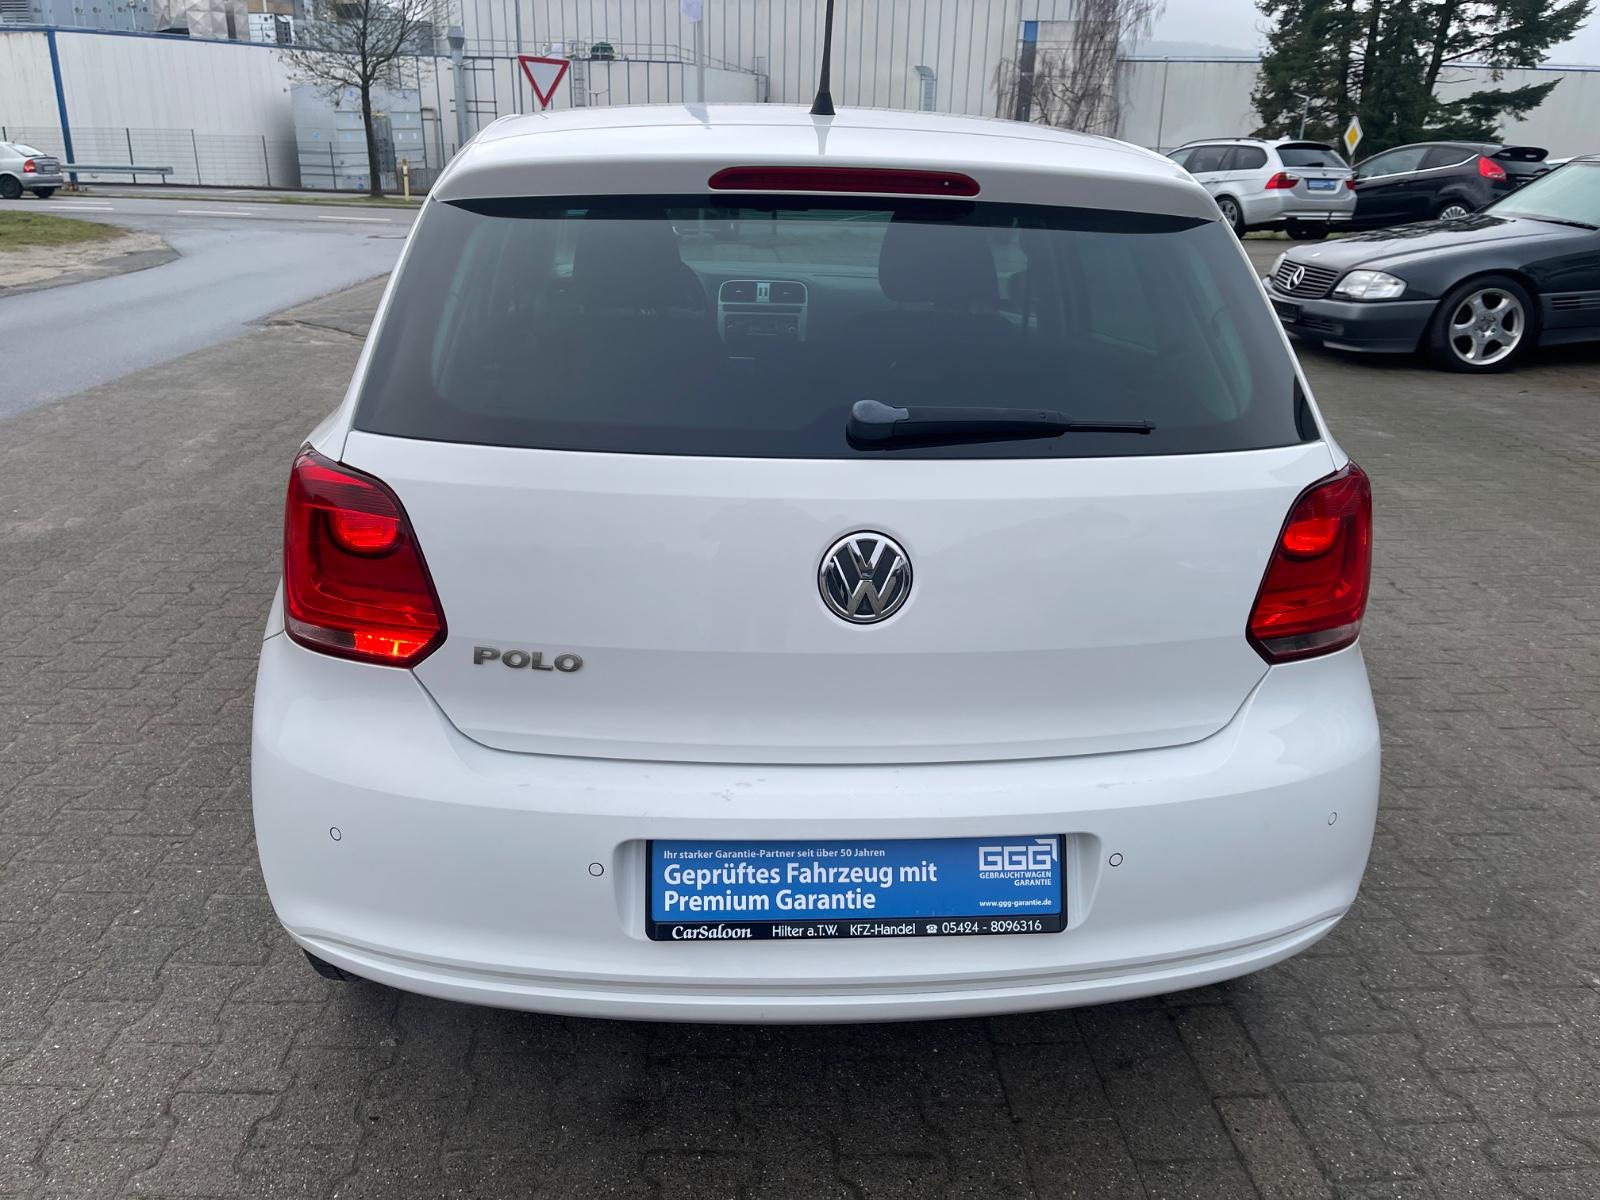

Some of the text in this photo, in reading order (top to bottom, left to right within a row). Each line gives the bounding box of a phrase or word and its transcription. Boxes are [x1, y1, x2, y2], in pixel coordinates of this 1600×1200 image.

[819, 532, 912, 623] VW
[473, 646, 583, 673] POLO
[663, 848, 886, 859] Ihr starker Garantie-Partner seit über 50 Jahren
[978, 845, 1052, 871] GGG
[663, 860, 938, 890] Geprüftes Fahrzeug mit
[979, 871, 1052, 880] GEBRAUCHTWAGEN
[1014, 878, 1052, 887] GARANTIE
[664, 888, 876, 912] Premium Garantie
[979, 898, 1052, 908] www.ggg-garantie.de
[671, 923, 753, 940] CarSaloon
[772, 924, 803, 937] Hilter
[806, 924, 839, 937] a.T.W.
[850, 923, 916, 936] KFZ-Handel
[942, 921, 979, 934] 05424
[990, 919, 1042, 933] 8096316
